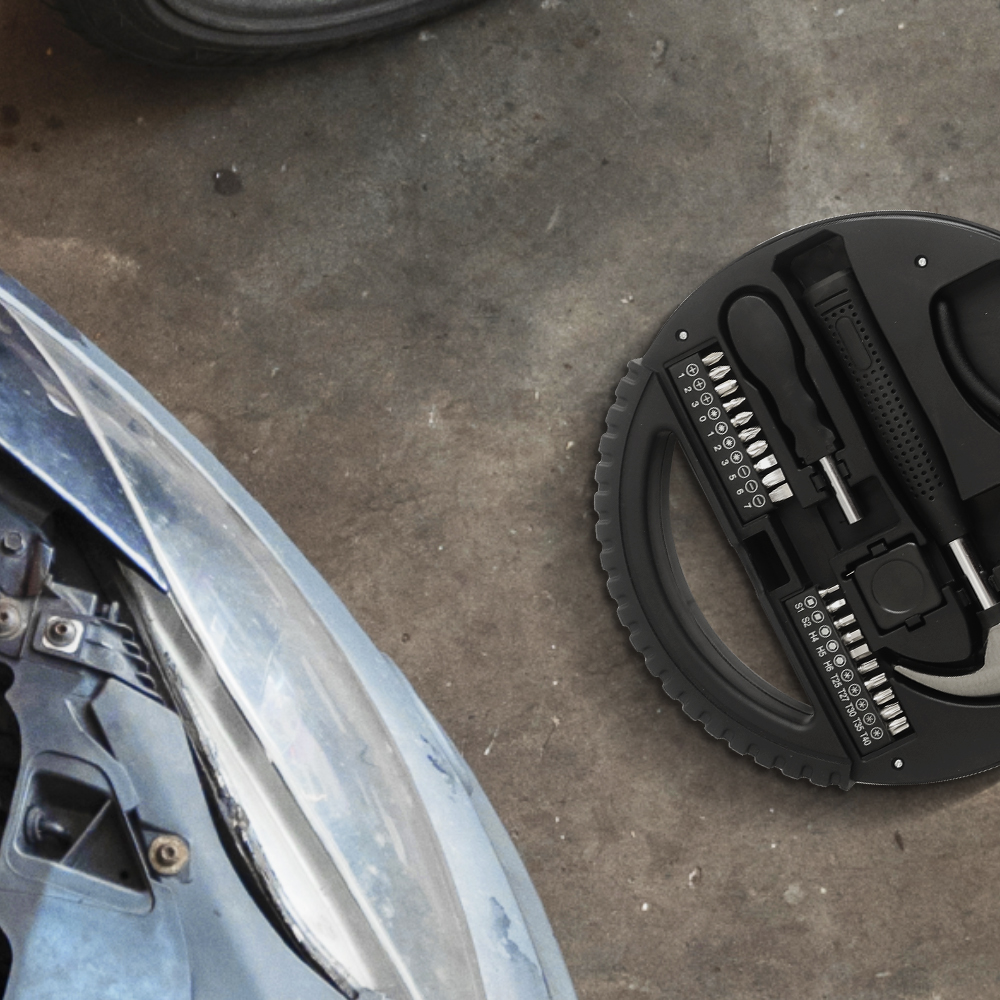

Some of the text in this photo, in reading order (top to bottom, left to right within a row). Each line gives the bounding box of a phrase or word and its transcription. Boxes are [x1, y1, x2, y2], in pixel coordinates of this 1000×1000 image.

[794, 602, 871, 746] S1 S2 H4 H5 H6 T25 T27 T30 T35 T40
